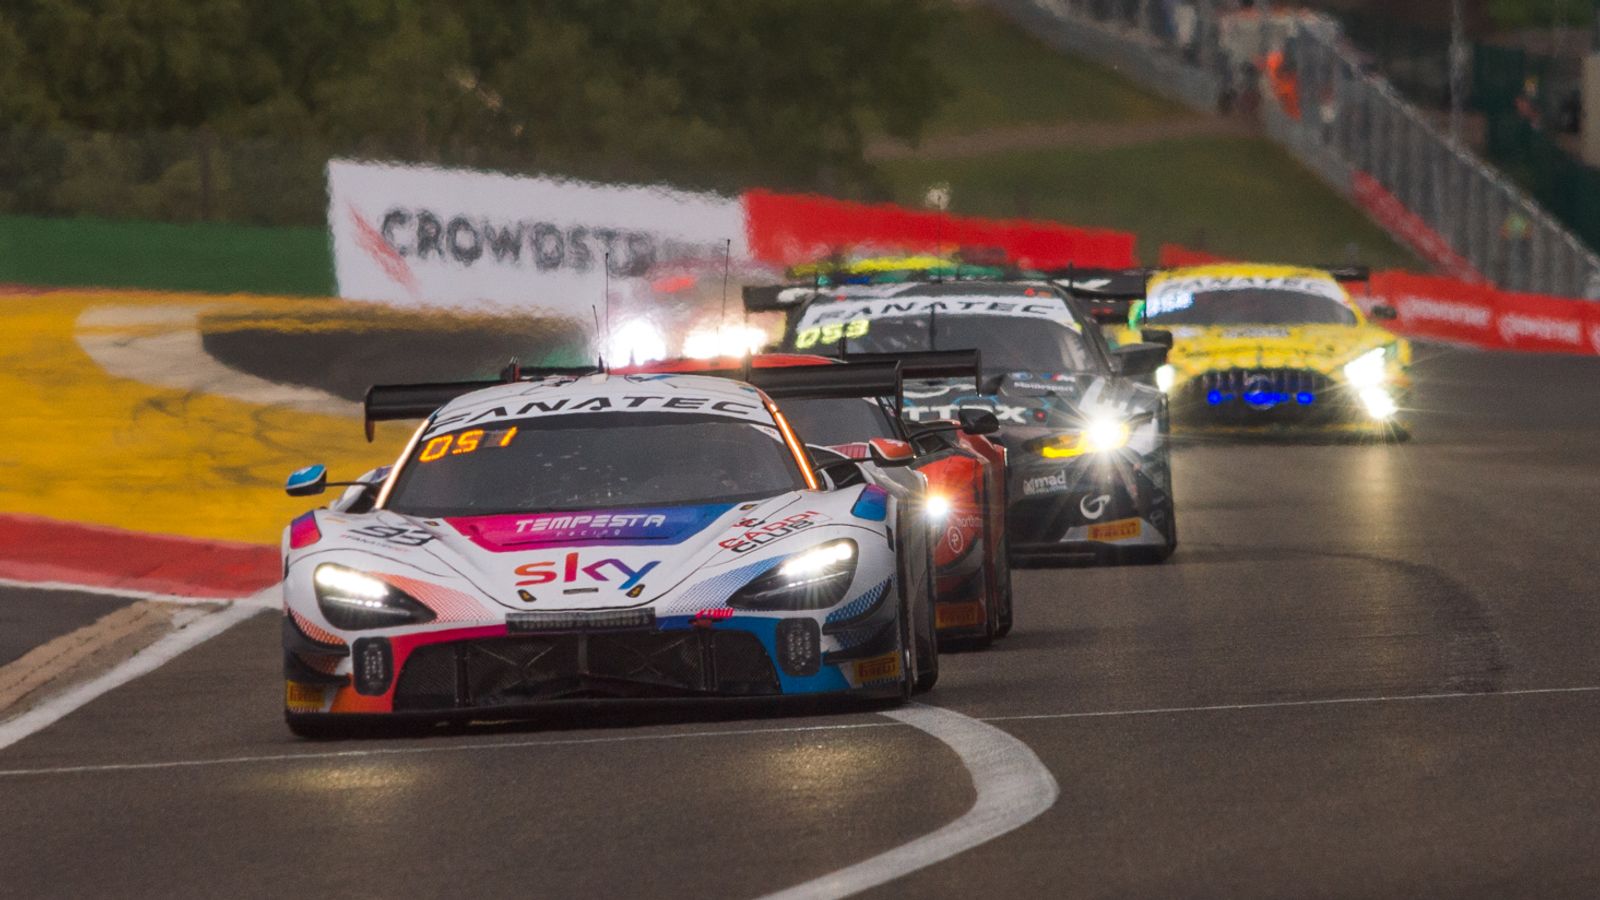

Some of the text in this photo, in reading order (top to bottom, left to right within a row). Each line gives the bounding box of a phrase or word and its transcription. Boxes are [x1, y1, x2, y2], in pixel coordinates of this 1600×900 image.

[812, 301, 1054, 325] FANATEC
[422, 396, 758, 436] FANATEC
[347, 526, 434, 547] 93
[515, 515, 666, 533] TEMPESTA
[731, 519, 815, 553] CLUB
[514, 552, 661, 590] sky
